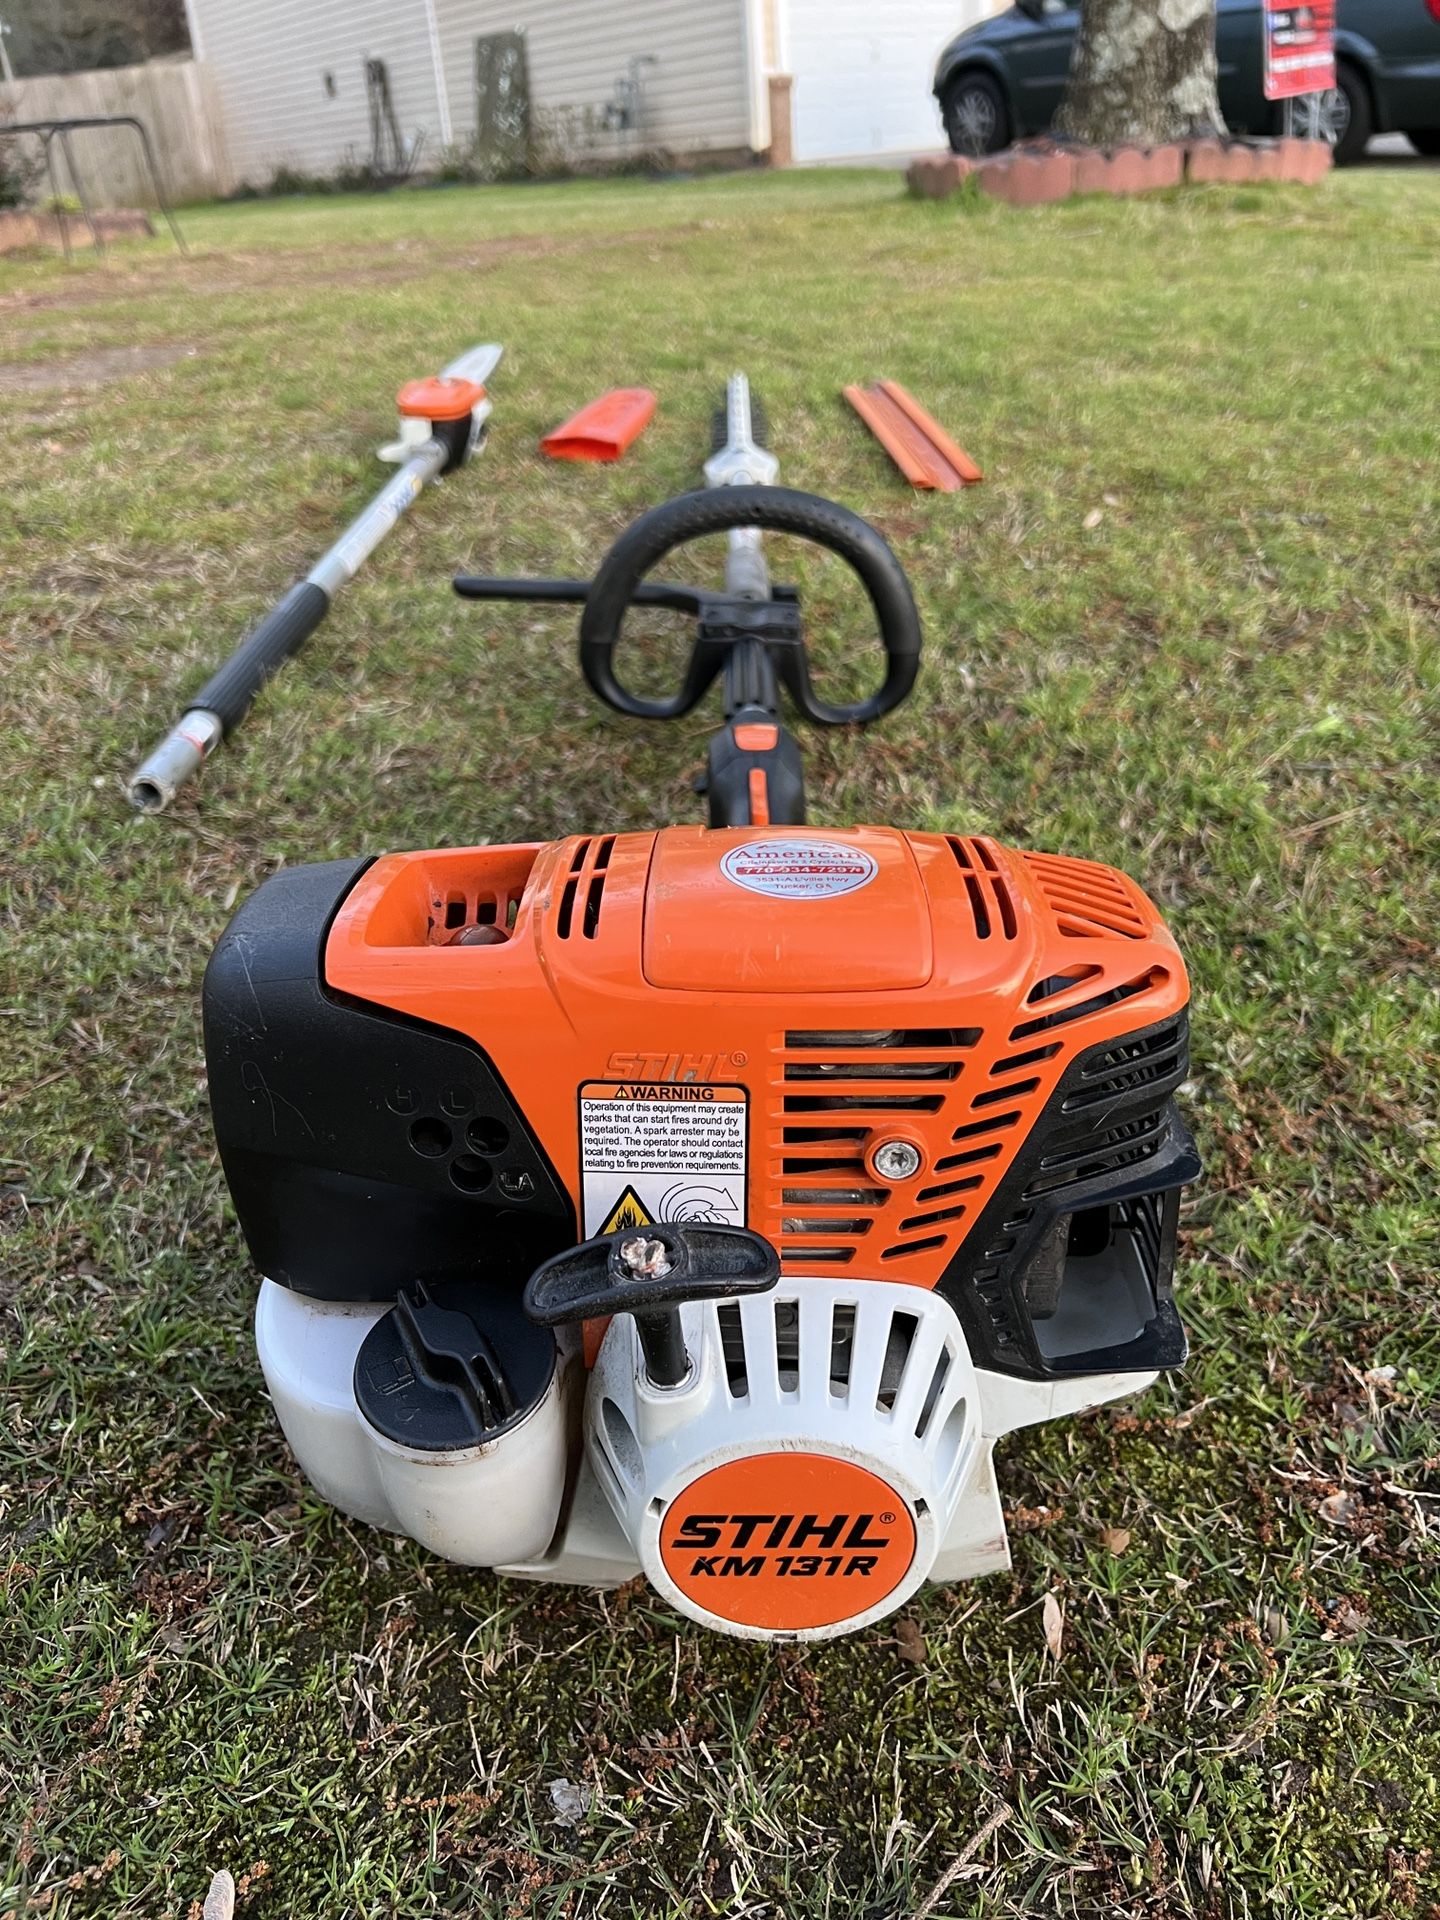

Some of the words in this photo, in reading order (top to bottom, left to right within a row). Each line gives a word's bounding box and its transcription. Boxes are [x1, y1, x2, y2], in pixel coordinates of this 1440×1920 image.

[732, 850, 861, 858] American
[630, 1087, 714, 1100] WARNING
[584, 1101, 624, 1112] Operation
[626, 1103, 635, 1111] of
[636, 1103, 650, 1111] this
[653, 1104, 696, 1114] equipment
[698, 1106, 716, 1115] may
[584, 1114, 612, 1123] sparks
[651, 1115, 670, 1123] start
[672, 1115, 690, 1124] fires
[692, 1116, 722, 1124] around
[725, 1117, 738, 1127] dry
[584, 1125, 632, 1135] vegetation.
[635, 1126, 641, 1134] A
[644, 1127, 668, 1136] spark
[670, 1128, 705, 1136] arrester
[707, 1129, 726, 1138] may
[728, 1128, 739, 1136] be
[584, 1137, 622, 1146] required.
[624, 1137, 641, 1145] The
[644, 1139, 679, 1148] operator
[682, 1139, 709, 1147] should
[585, 1147, 603, 1156] local
[605, 1147, 617, 1156] fire
[619, 1149, 655, 1158] agencies
[657, 1149, 668, 1157] for
[669, 1149, 687, 1158] laws
[699, 1150, 743, 1160] regulations
[585, 1159, 615, 1169] relating
[627, 1159, 639, 1168] fire
[641, 1161, 683, 1170] prevention
[686, 1161, 741, 1171] requirements.
[690, 1555, 767, 1576] KM
[774, 1555, 879, 1576] 131R
